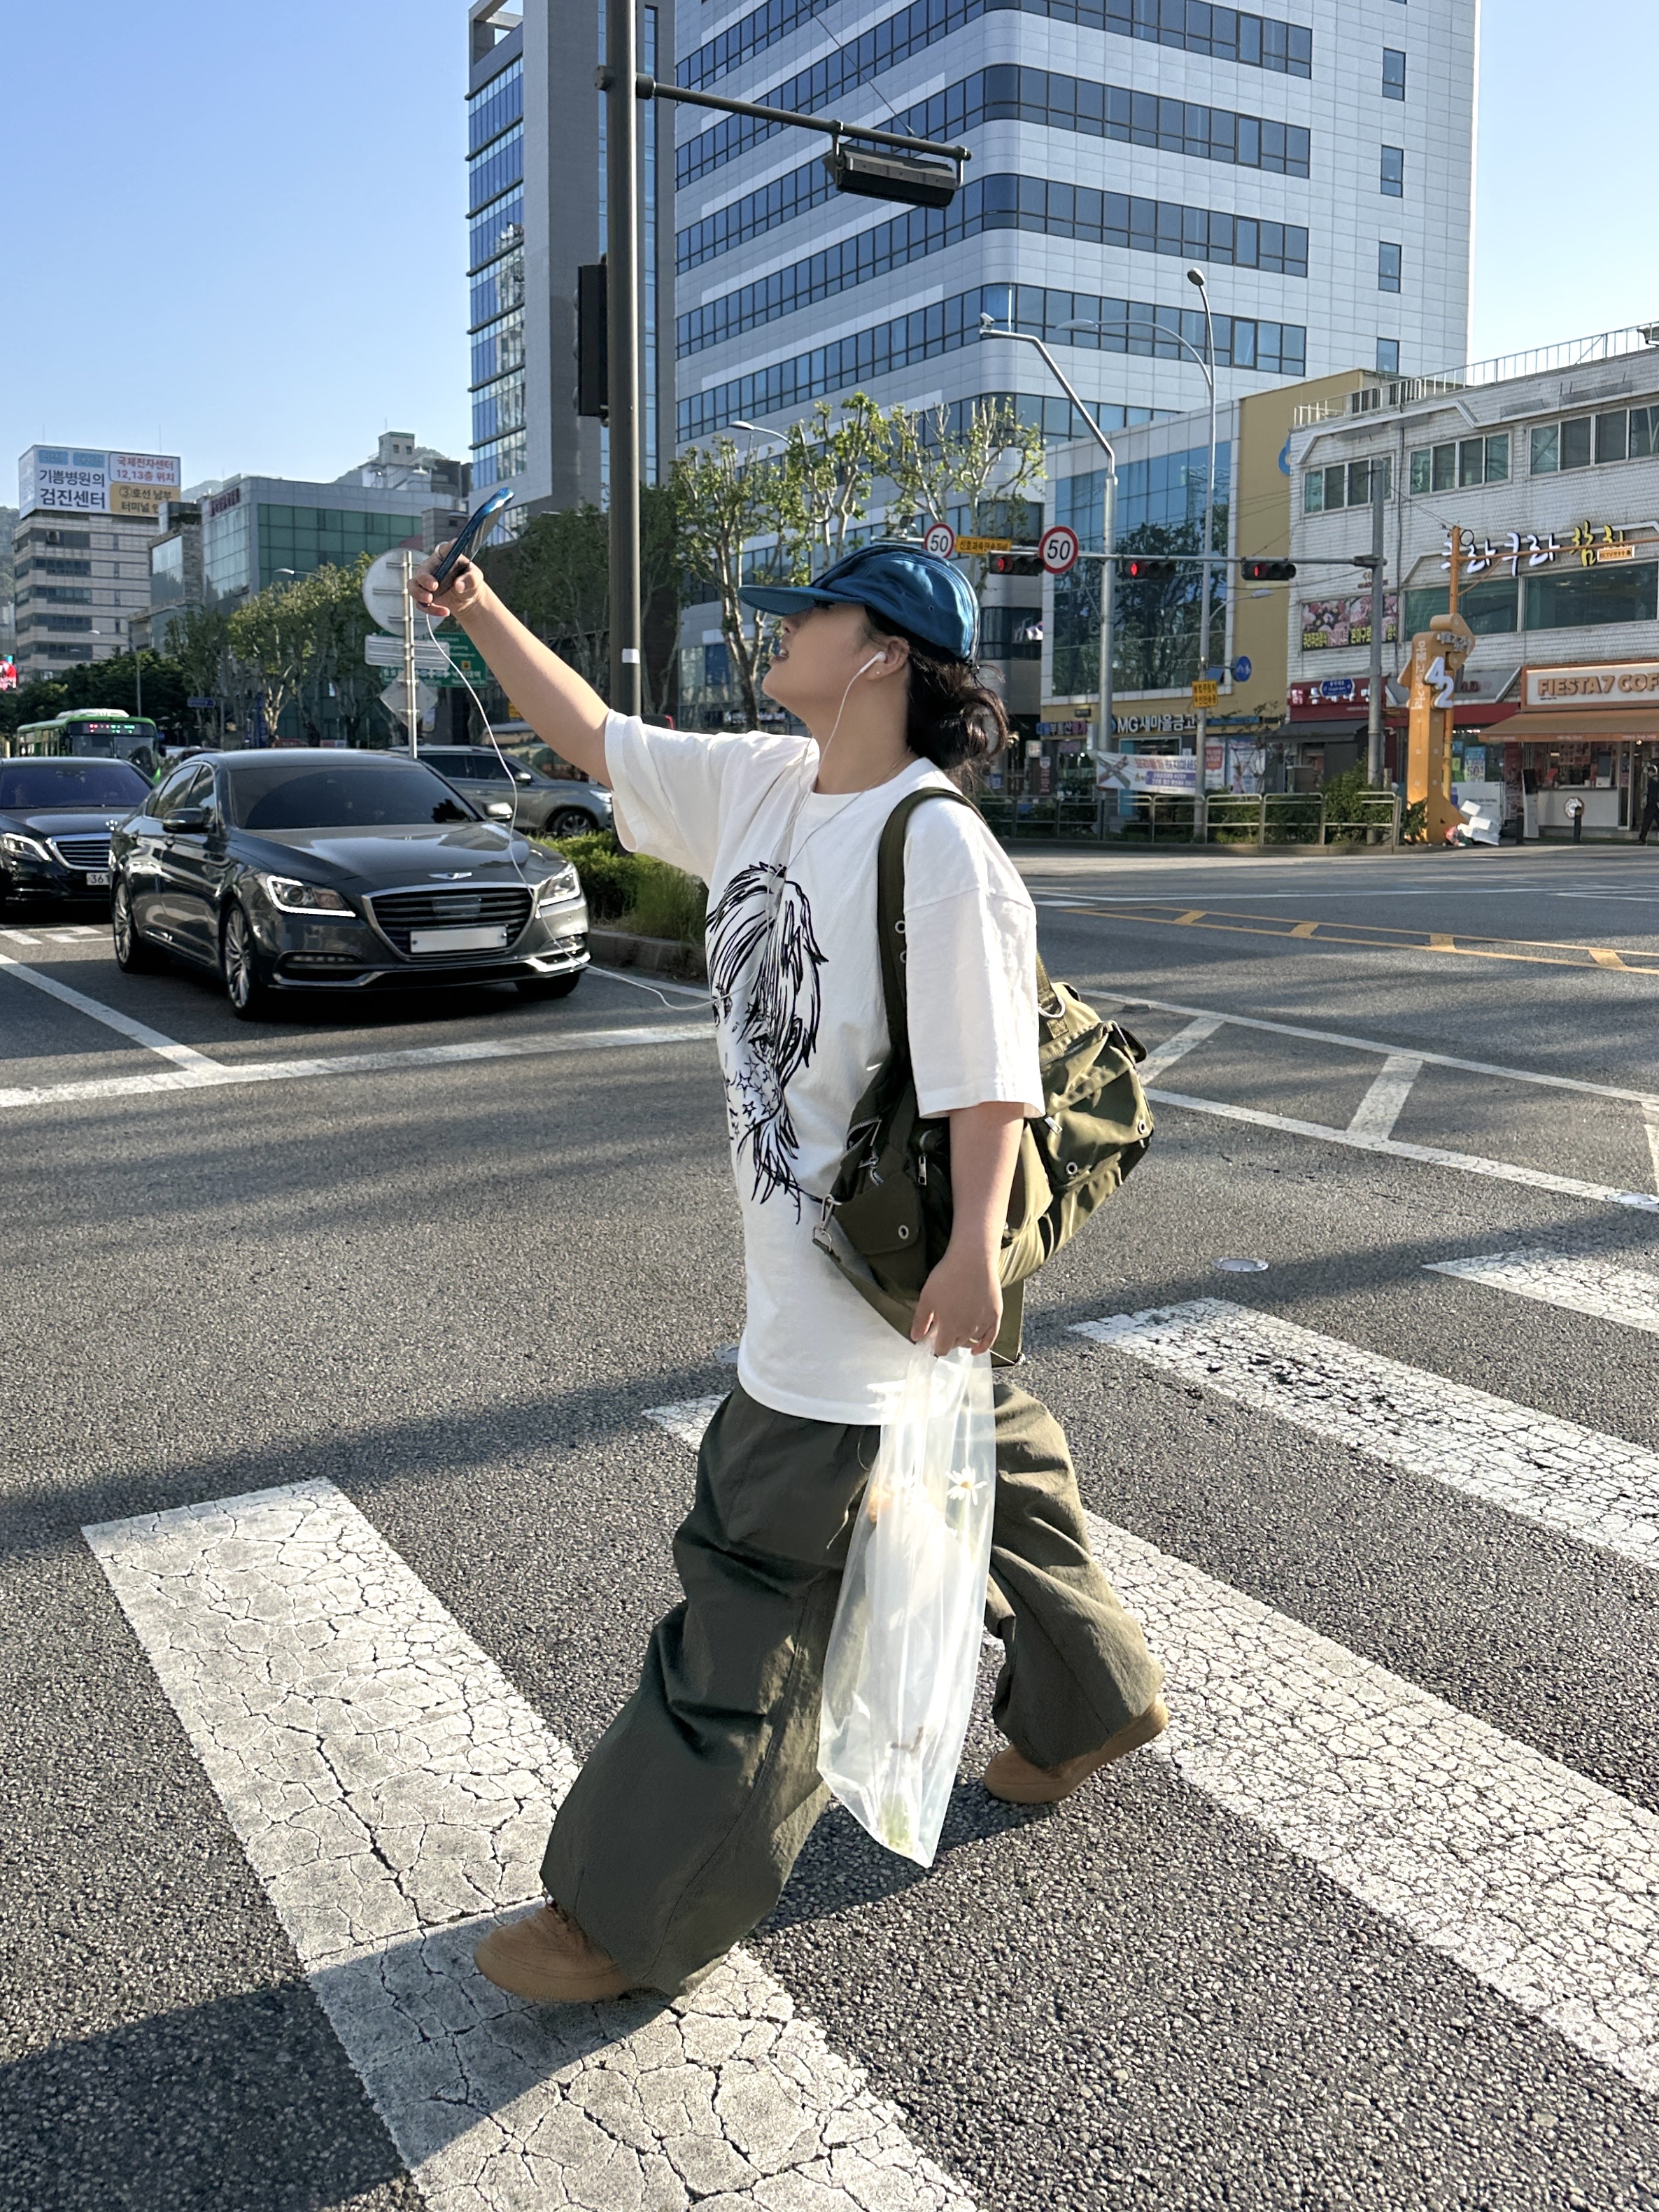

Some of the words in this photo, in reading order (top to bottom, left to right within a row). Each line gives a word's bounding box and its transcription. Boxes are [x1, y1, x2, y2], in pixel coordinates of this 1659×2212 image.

[117, 456, 174, 470] 국제전자센터
[116, 469, 153, 481] 12,13층
[40, 488, 105, 509] 검진센터
[120, 502, 150, 513] 터미널
[930, 534, 949, 552] 50
[1047, 540, 1071, 561] 50
[1618, 672, 1659, 692] COF
